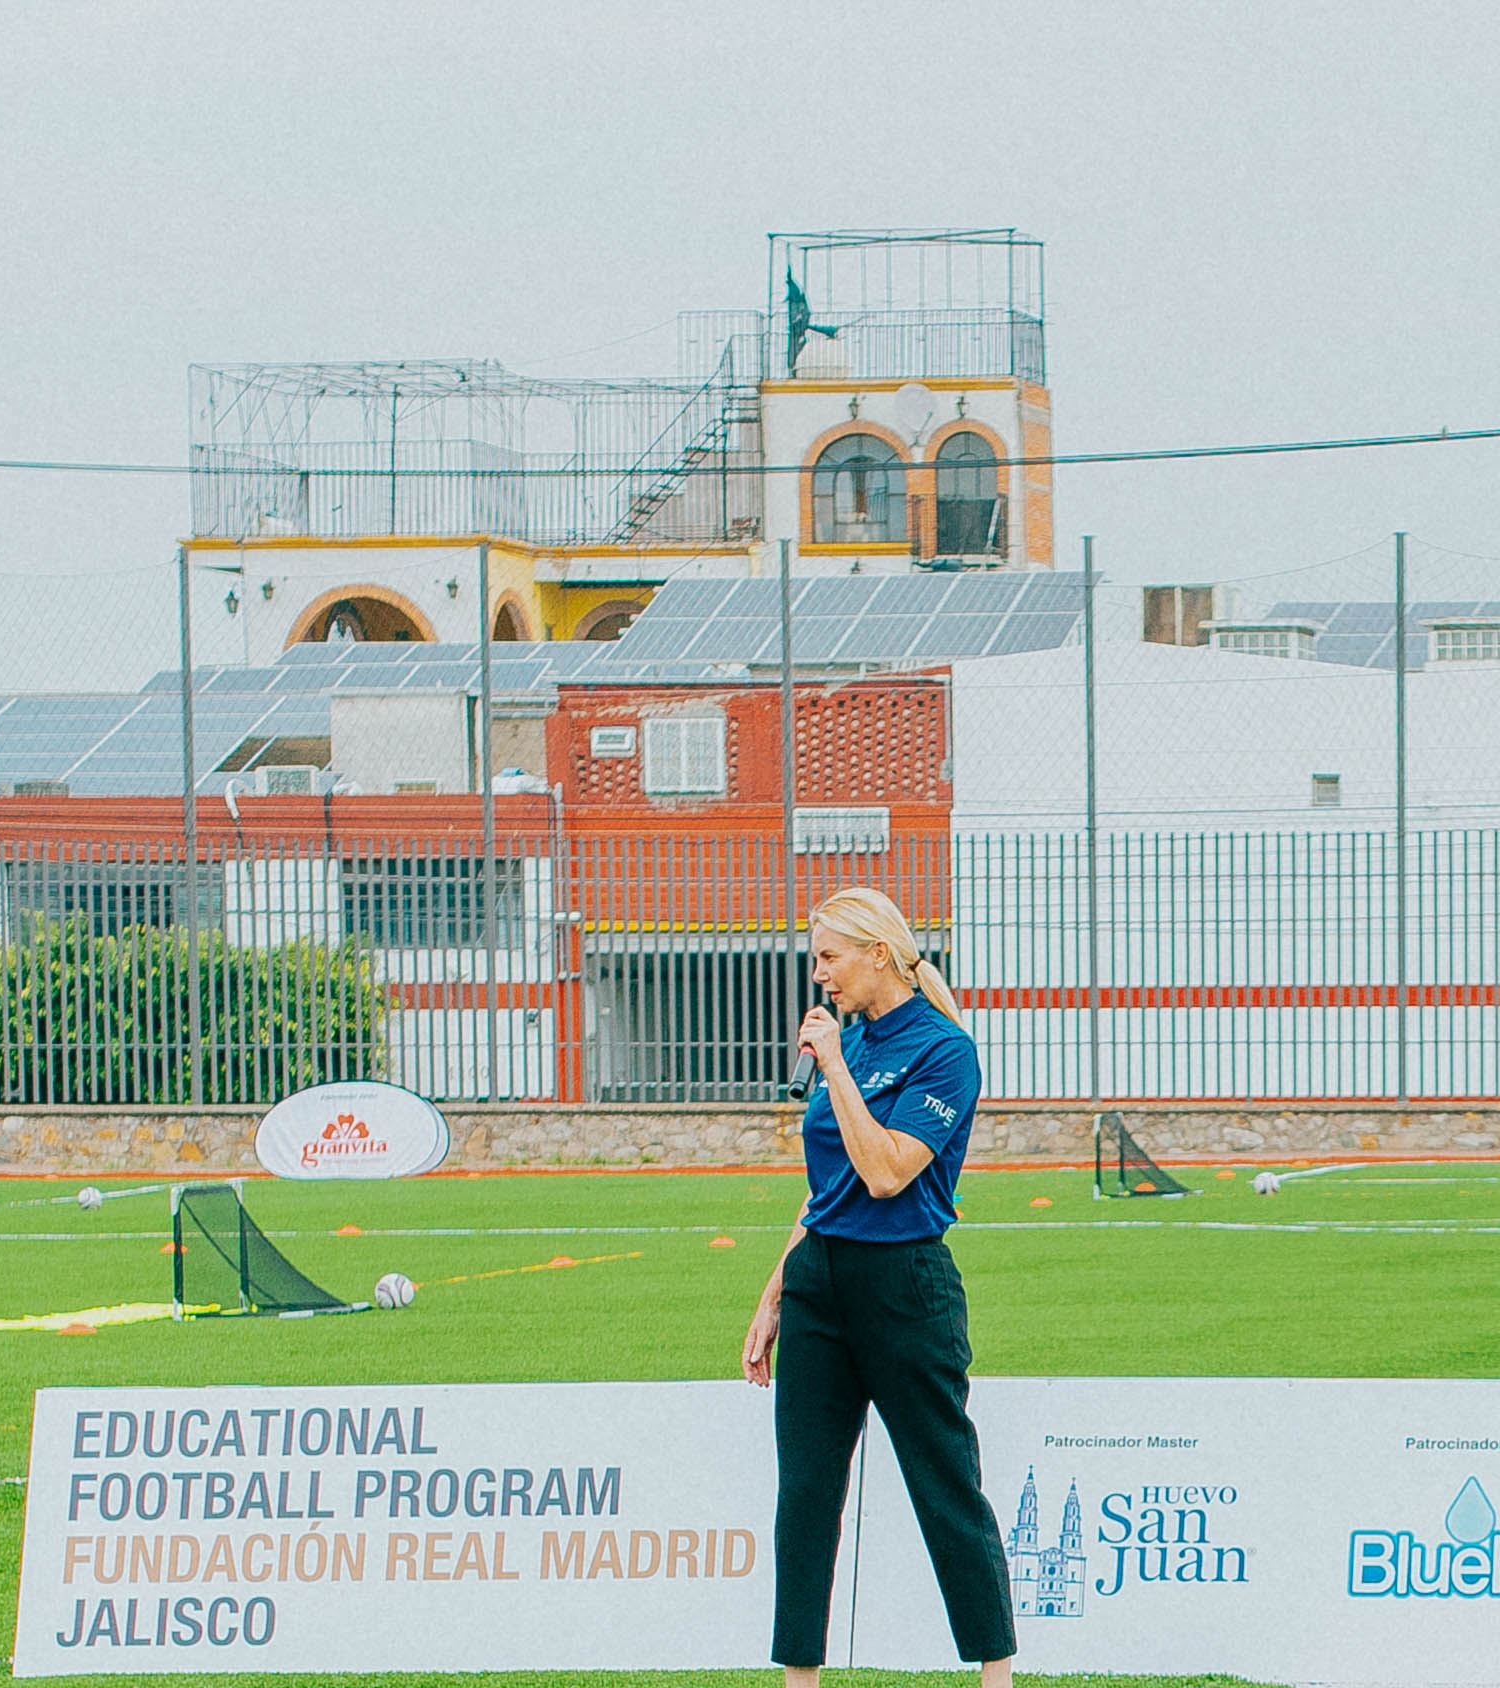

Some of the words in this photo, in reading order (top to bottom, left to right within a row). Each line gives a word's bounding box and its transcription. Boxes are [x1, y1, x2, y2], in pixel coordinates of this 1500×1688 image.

[923, 1094, 957, 1122] TRUE
[301, 1139, 388, 1168] granvita
[73, 1406, 439, 1459] EDUCATIONAL
[1044, 1434, 1143, 1449] Patrocinador
[1146, 1436, 1199, 1449] Master
[67, 1470, 336, 1521] FOOTBALL
[353, 1466, 622, 1518] PROGRAM
[1098, 1493, 1211, 1544] San
[62, 1521, 367, 1584] FUNDACIÓN
[385, 1530, 520, 1582] REAL
[539, 1528, 757, 1580] MADRID
[1095, 1545, 1250, 1596] Juan
[55, 1595, 277, 1647] JALISCO
